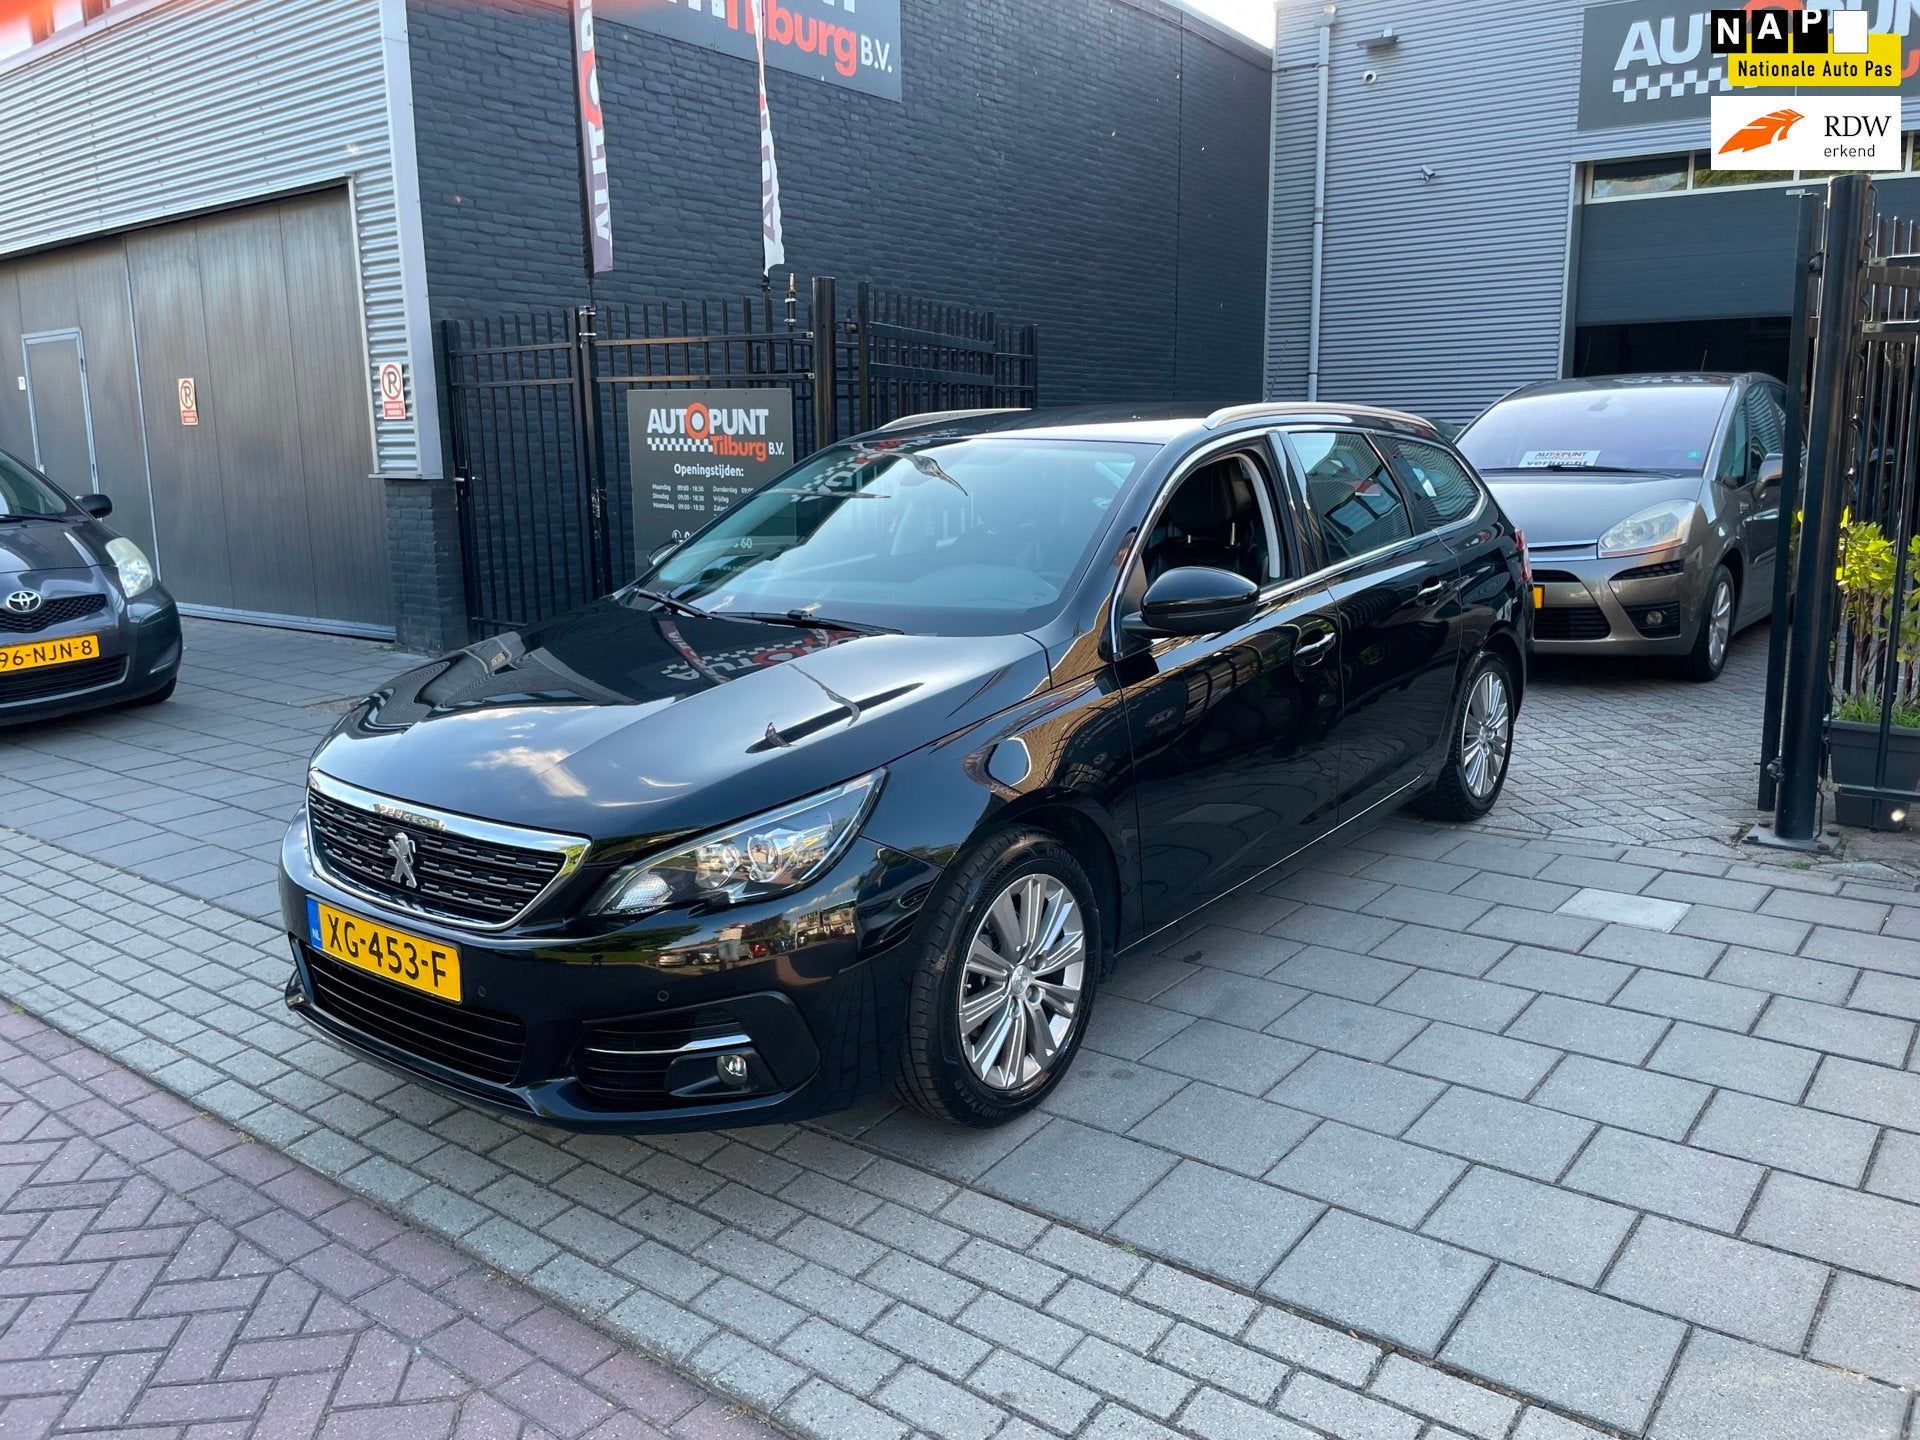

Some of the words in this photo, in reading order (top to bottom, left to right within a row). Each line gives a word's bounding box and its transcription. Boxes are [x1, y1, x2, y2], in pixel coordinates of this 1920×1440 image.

[860, 34, 893, 73] B.V.
[647, 402, 769, 440] AUTOPUNT
[710, 434, 767, 462] Tilburg
[768, 441, 785, 456] B.V.
[674, 463, 744, 479] Openingstijden:
[712, 485, 738, 494] Donderdag
[0, 640, 93, 668] 96-NJN-8
[380, 804, 437, 829] PEUGEOT
[312, 928, 322, 941] NL
[327, 913, 446, 988] XG-453-F
